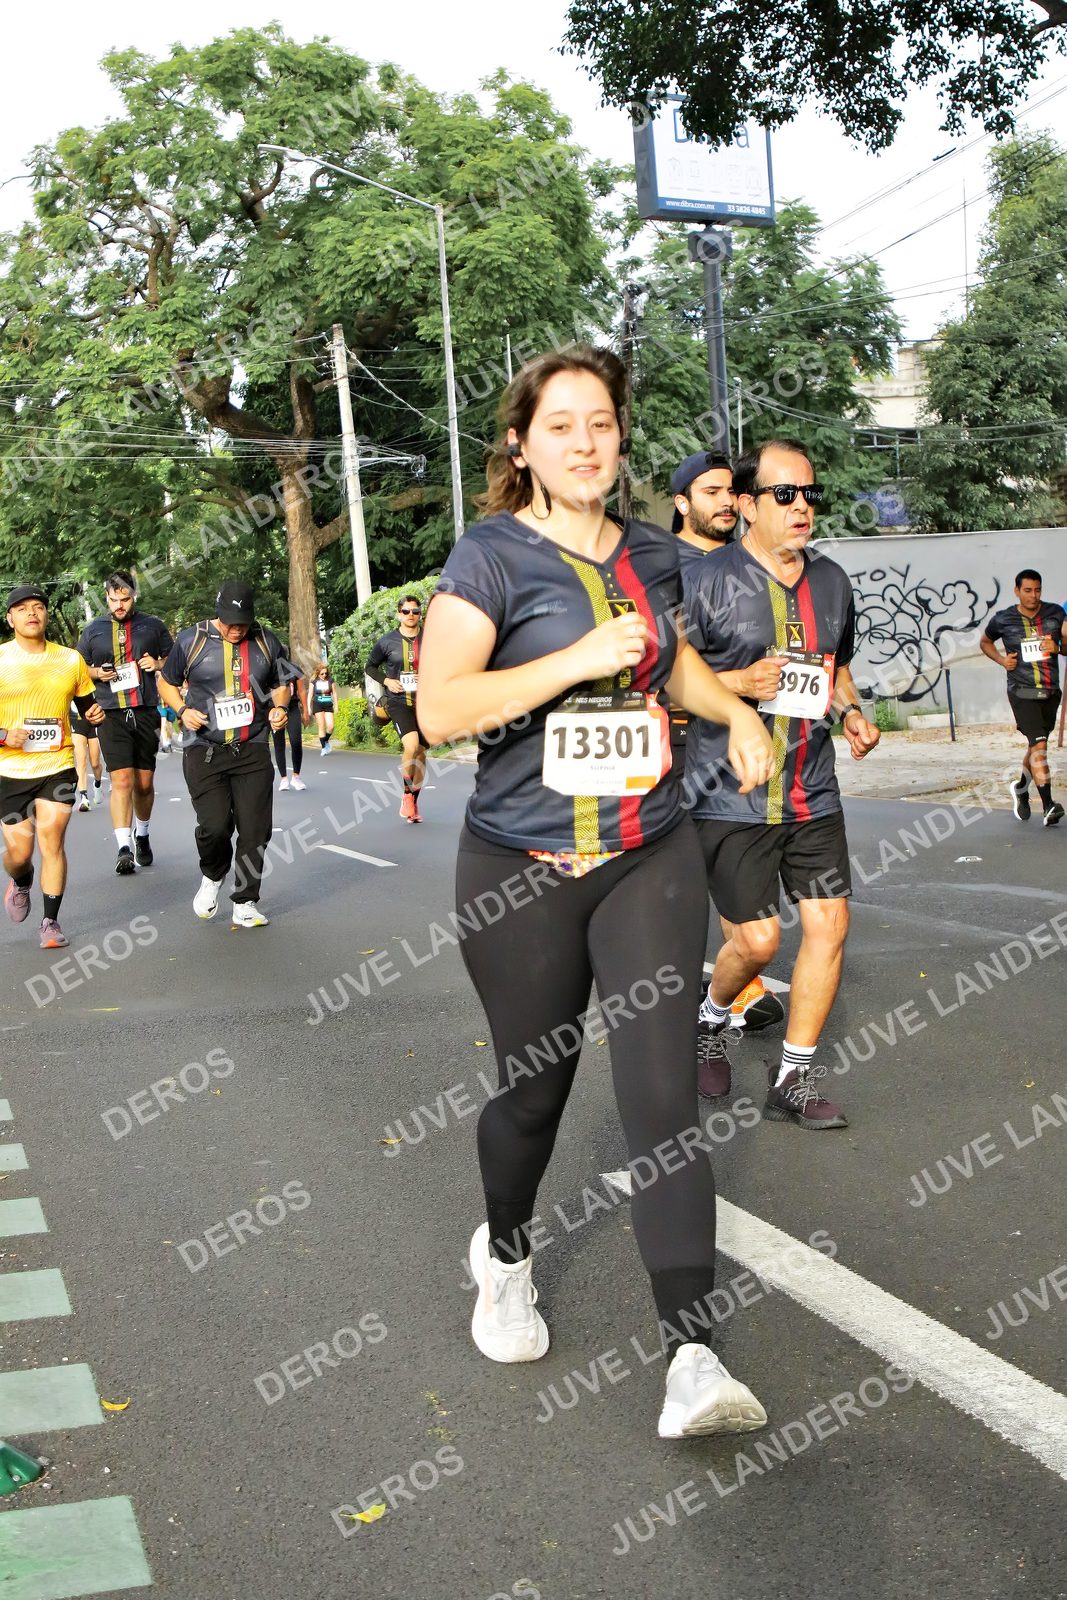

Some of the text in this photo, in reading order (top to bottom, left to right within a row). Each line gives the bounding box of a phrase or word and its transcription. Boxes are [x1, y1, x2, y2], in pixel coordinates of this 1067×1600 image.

[850, 564, 911, 588] TOY
[217, 702, 251, 718] 11120
[28, 729, 57, 741] 8999
[552, 724, 649, 760] 13301
